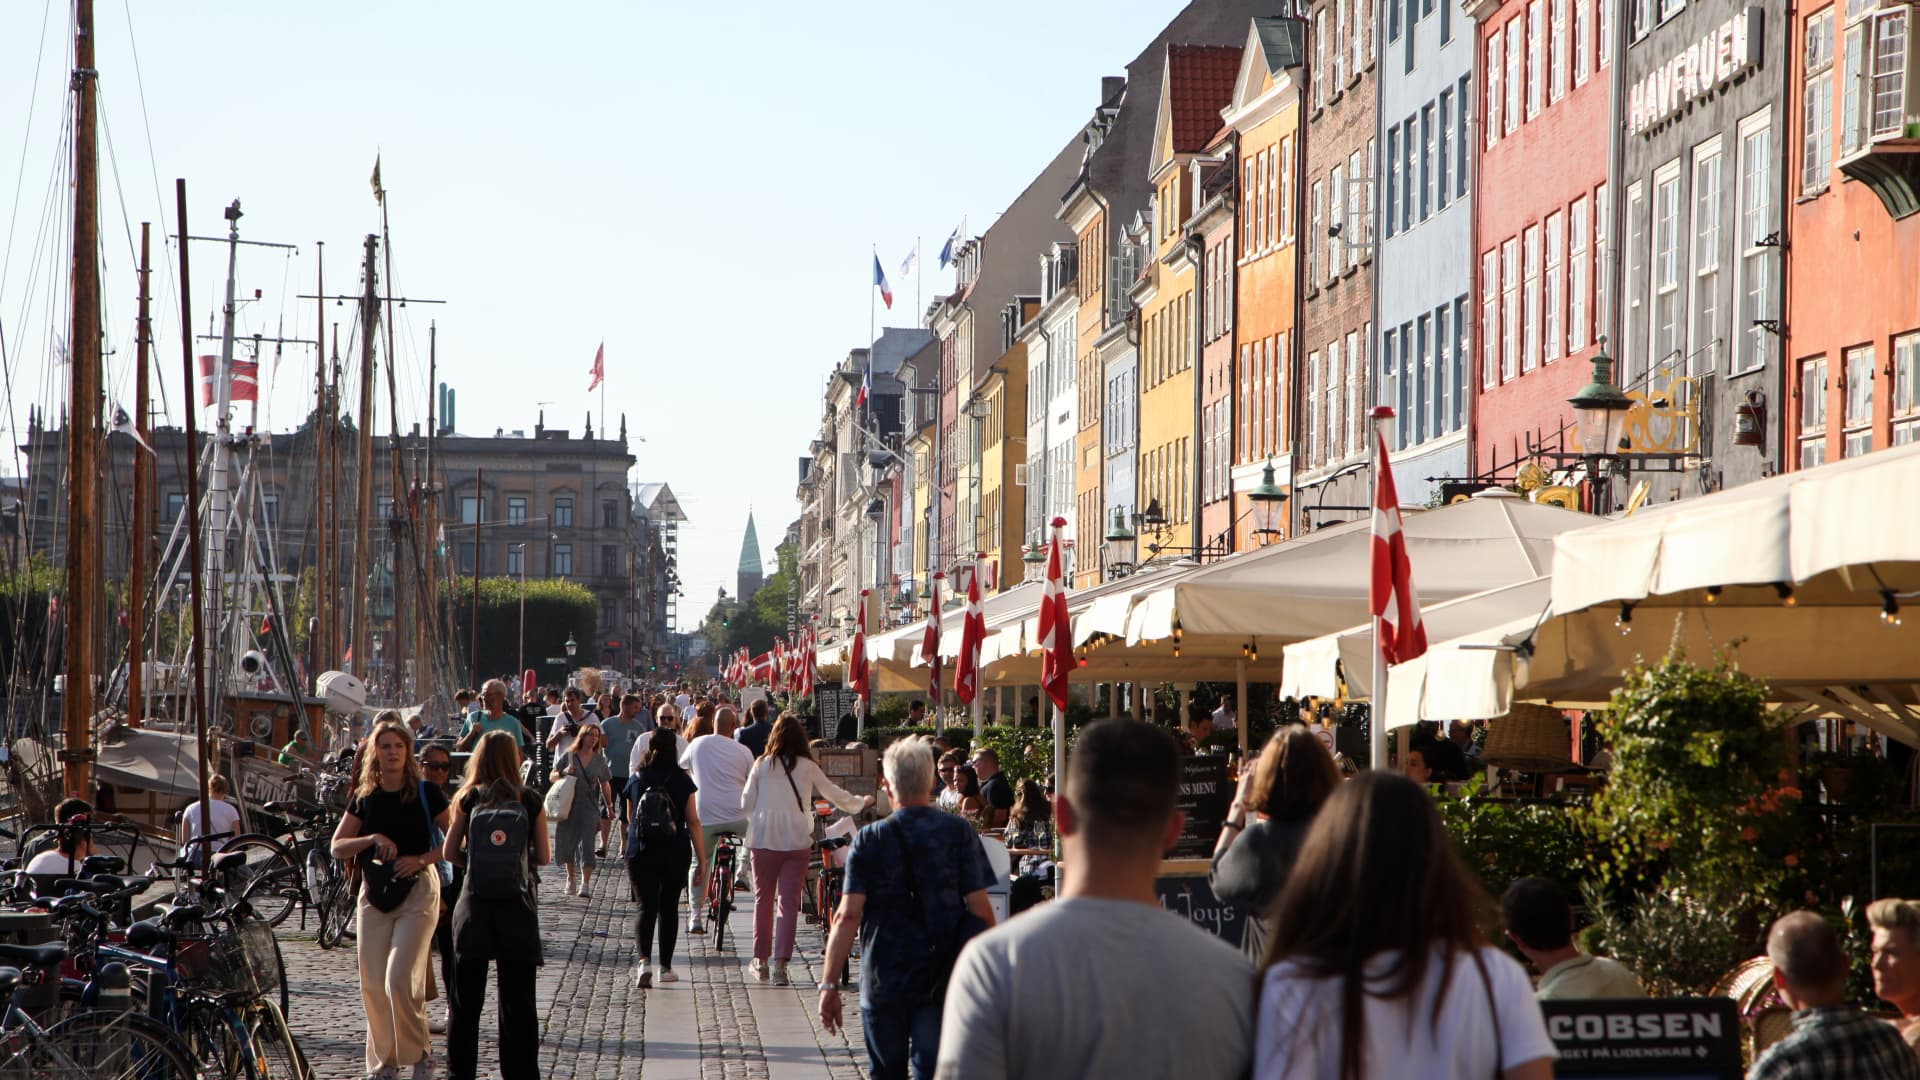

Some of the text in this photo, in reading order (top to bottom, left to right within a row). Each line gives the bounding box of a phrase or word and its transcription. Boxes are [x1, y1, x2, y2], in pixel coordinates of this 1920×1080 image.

[1630, 7, 1750, 136] HAVFRUEN
[950, 565, 976, 592] 17
[787, 579, 796, 631] BOLTENS
[242, 771, 298, 802] EMMA
[1192, 782, 1217, 795] MENU
[1550, 1012, 1722, 1040] COBSEN
